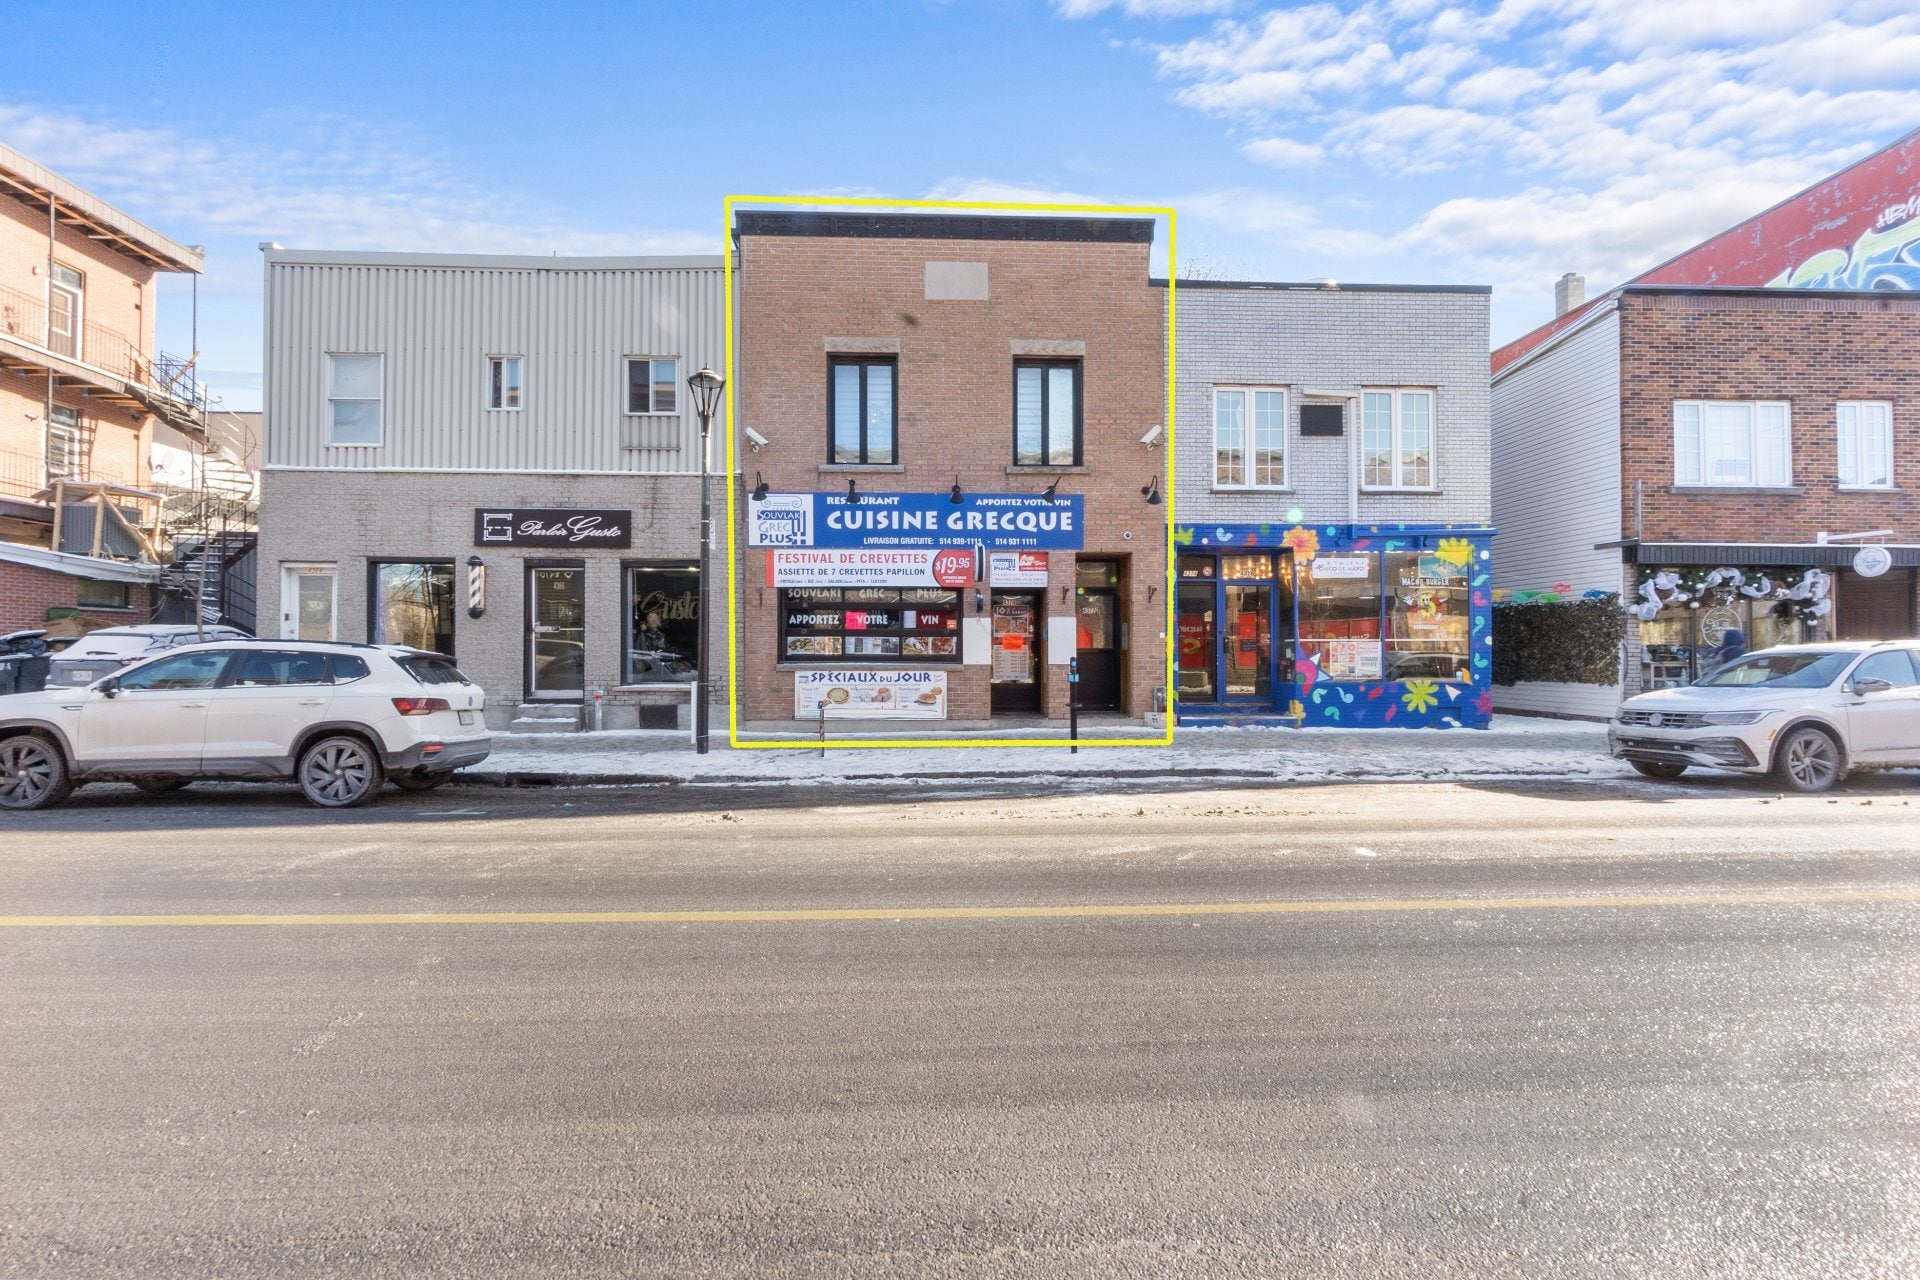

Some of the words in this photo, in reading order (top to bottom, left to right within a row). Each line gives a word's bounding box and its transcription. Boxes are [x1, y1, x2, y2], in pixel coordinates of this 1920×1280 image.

[758, 521, 790, 532] GREC
[827, 511, 938, 530] CUISINE
[946, 512, 1072, 532] GRECQUE
[516, 520, 568, 536] Parloir
[566, 516, 622, 542] Gusto
[778, 554, 834, 564] FESTIVAL
[840, 554, 855, 564] DE
[860, 554, 928, 564] CREVETTES
[936, 556, 970, 574] $19.95
[1402, 577, 1424, 586] MACHO
[1426, 578, 1449, 586] BURGER
[788, 588, 840, 598] SOUVLAKI
[860, 588, 884, 598] GREC
[789, 615, 840, 624] APPORTEZ
[856, 615, 888, 624] VOTRE
[921, 615, 939, 624] VIN
[811, 671, 877, 682] SPÉCIAUX
[895, 672, 931, 682] JOUR
